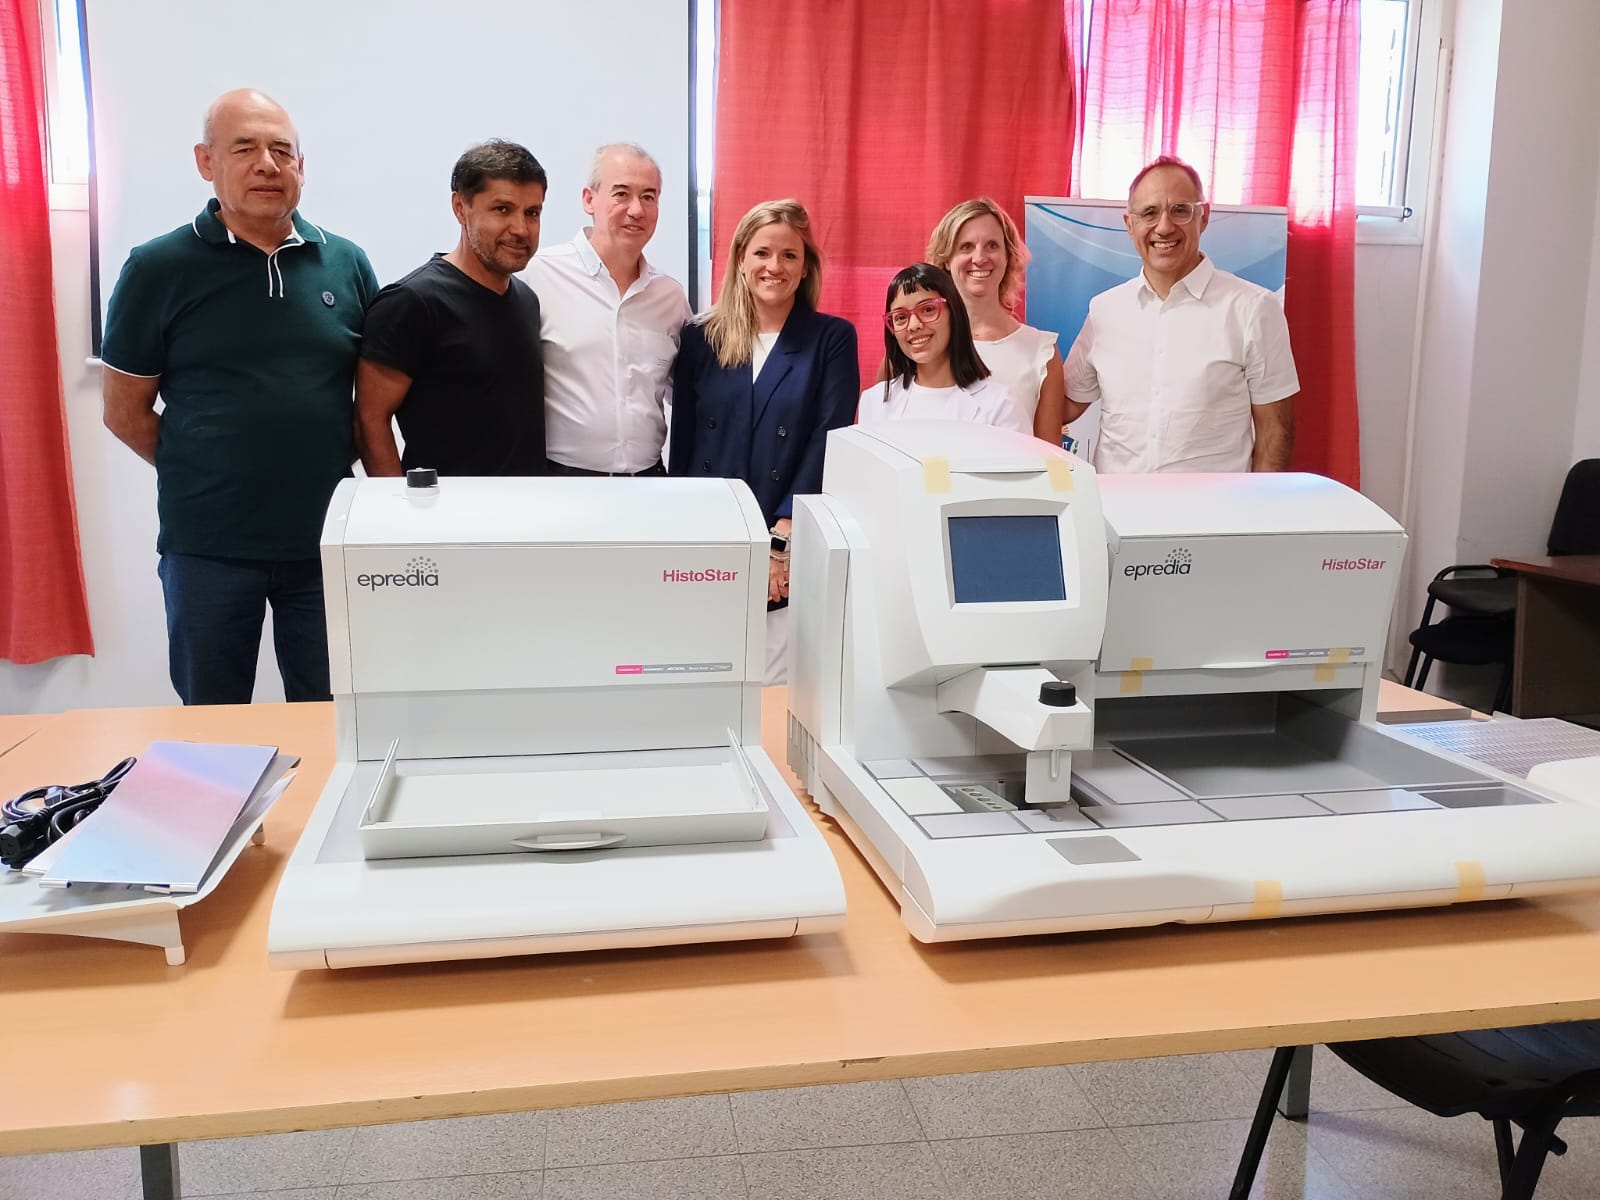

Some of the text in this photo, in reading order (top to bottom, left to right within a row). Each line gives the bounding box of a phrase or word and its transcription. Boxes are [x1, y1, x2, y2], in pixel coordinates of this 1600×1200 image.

[1123, 559, 1191, 581] epredia
[1321, 557, 1387, 571] HistoStar
[357, 568, 439, 592] epredia
[663, 568, 739, 582] HistoStar
